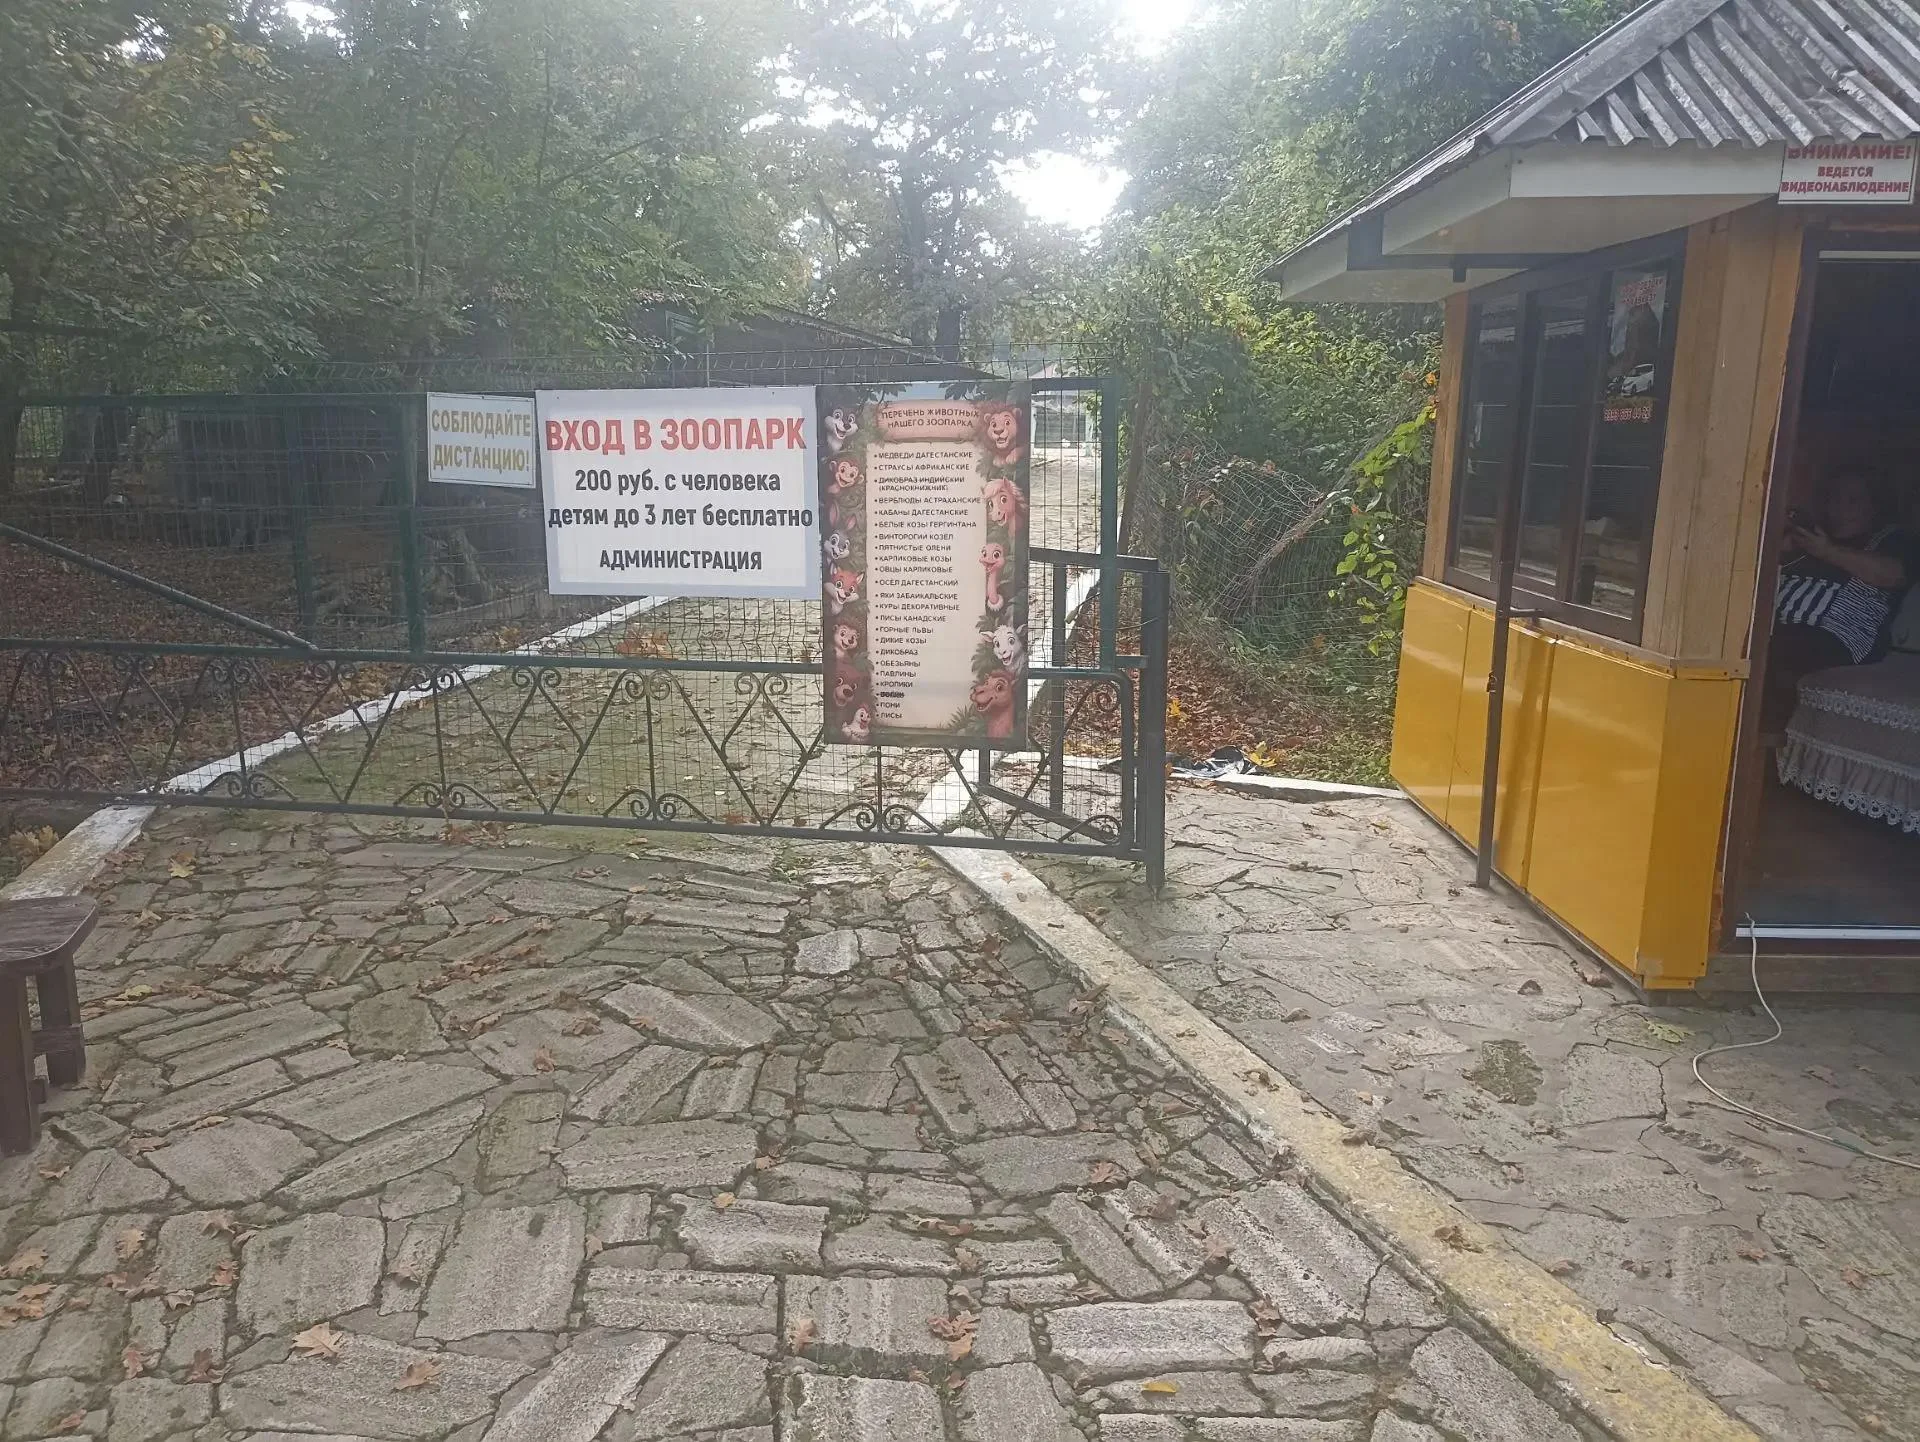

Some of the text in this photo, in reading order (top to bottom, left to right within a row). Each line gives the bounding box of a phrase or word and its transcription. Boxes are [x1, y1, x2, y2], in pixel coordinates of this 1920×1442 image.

[1788, 144, 1910, 159] ВНИМАНИЕ!
[1818, 166, 1874, 178] ВЕДЕТСЯ
[1781, 181, 1909, 194] ВИДЕОНАБЛЮДЕНИЕ
[431, 408, 532, 438] СОБЛЮДАЙТЕ
[882, 409, 979, 419] ПЕРЕЧЕНЬ ЖИВОТНЫХ
[888, 418, 974, 428] НАШЕГО ЗООПАРКА
[546, 417, 807, 455] ВХОД В ЗООПАРК
[433, 445, 530, 473] ДИСТАНЦИЮ!
[575, 469, 780, 495] 200 руб. с человека
[549, 504, 812, 529] детям до 3 лет бесплатно
[600, 550, 762, 572] АДМИНИСТРАЦИЯ
